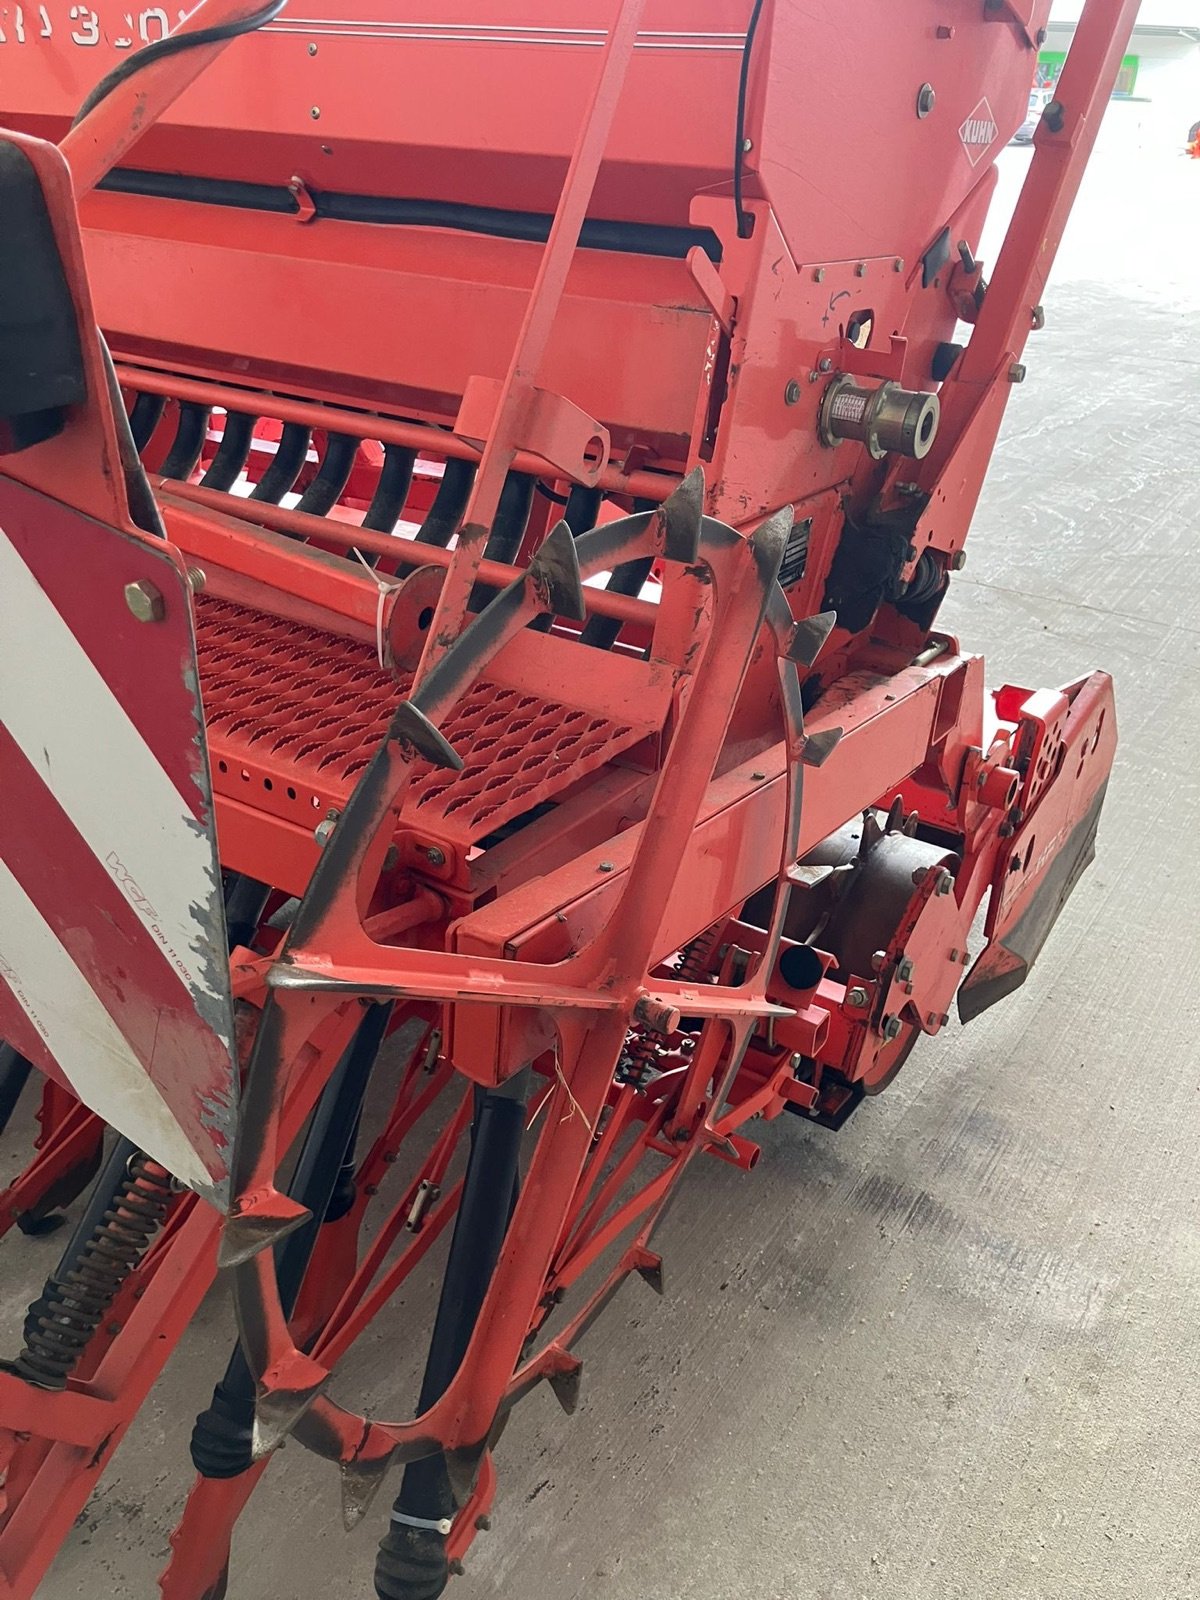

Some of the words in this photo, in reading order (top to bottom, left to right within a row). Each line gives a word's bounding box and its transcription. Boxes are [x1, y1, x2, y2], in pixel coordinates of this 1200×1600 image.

[963, 119, 995, 144] KUHN
[151, 924, 168, 945] DIN
[167, 948, 177, 958] 11
[175, 960, 193, 981] 030
